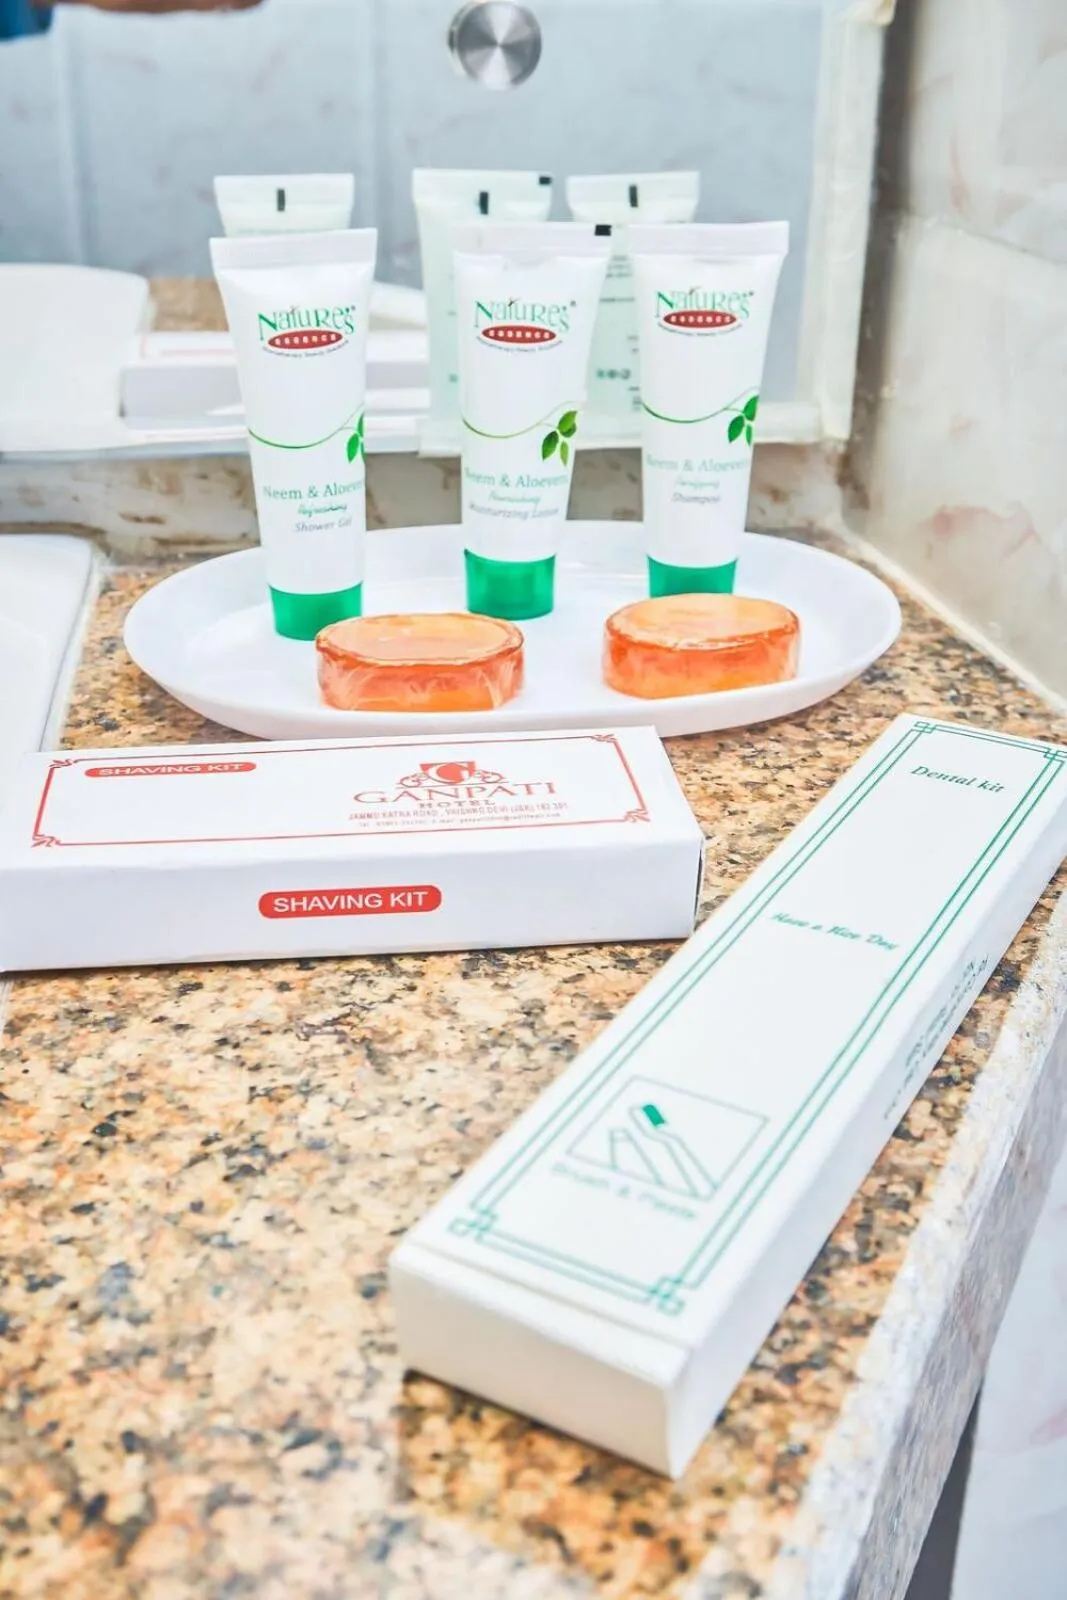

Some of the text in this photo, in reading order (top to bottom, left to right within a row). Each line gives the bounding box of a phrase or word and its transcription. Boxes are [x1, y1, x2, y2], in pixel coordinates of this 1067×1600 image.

[500, 473, 510, 487] &
[263, 485, 303, 499] Neem
[308, 484, 318, 498] &
[295, 521, 335, 533] Shower
[98, 763, 243, 775] SHAVING KIT
[910, 765, 1008, 794] Dental kit
[353, 782, 557, 804] GANPATI
[419, 799, 495, 808] HOTEL
[272, 890, 428, 913] SHAVING KIT
[866, 934, 901, 951] Day
